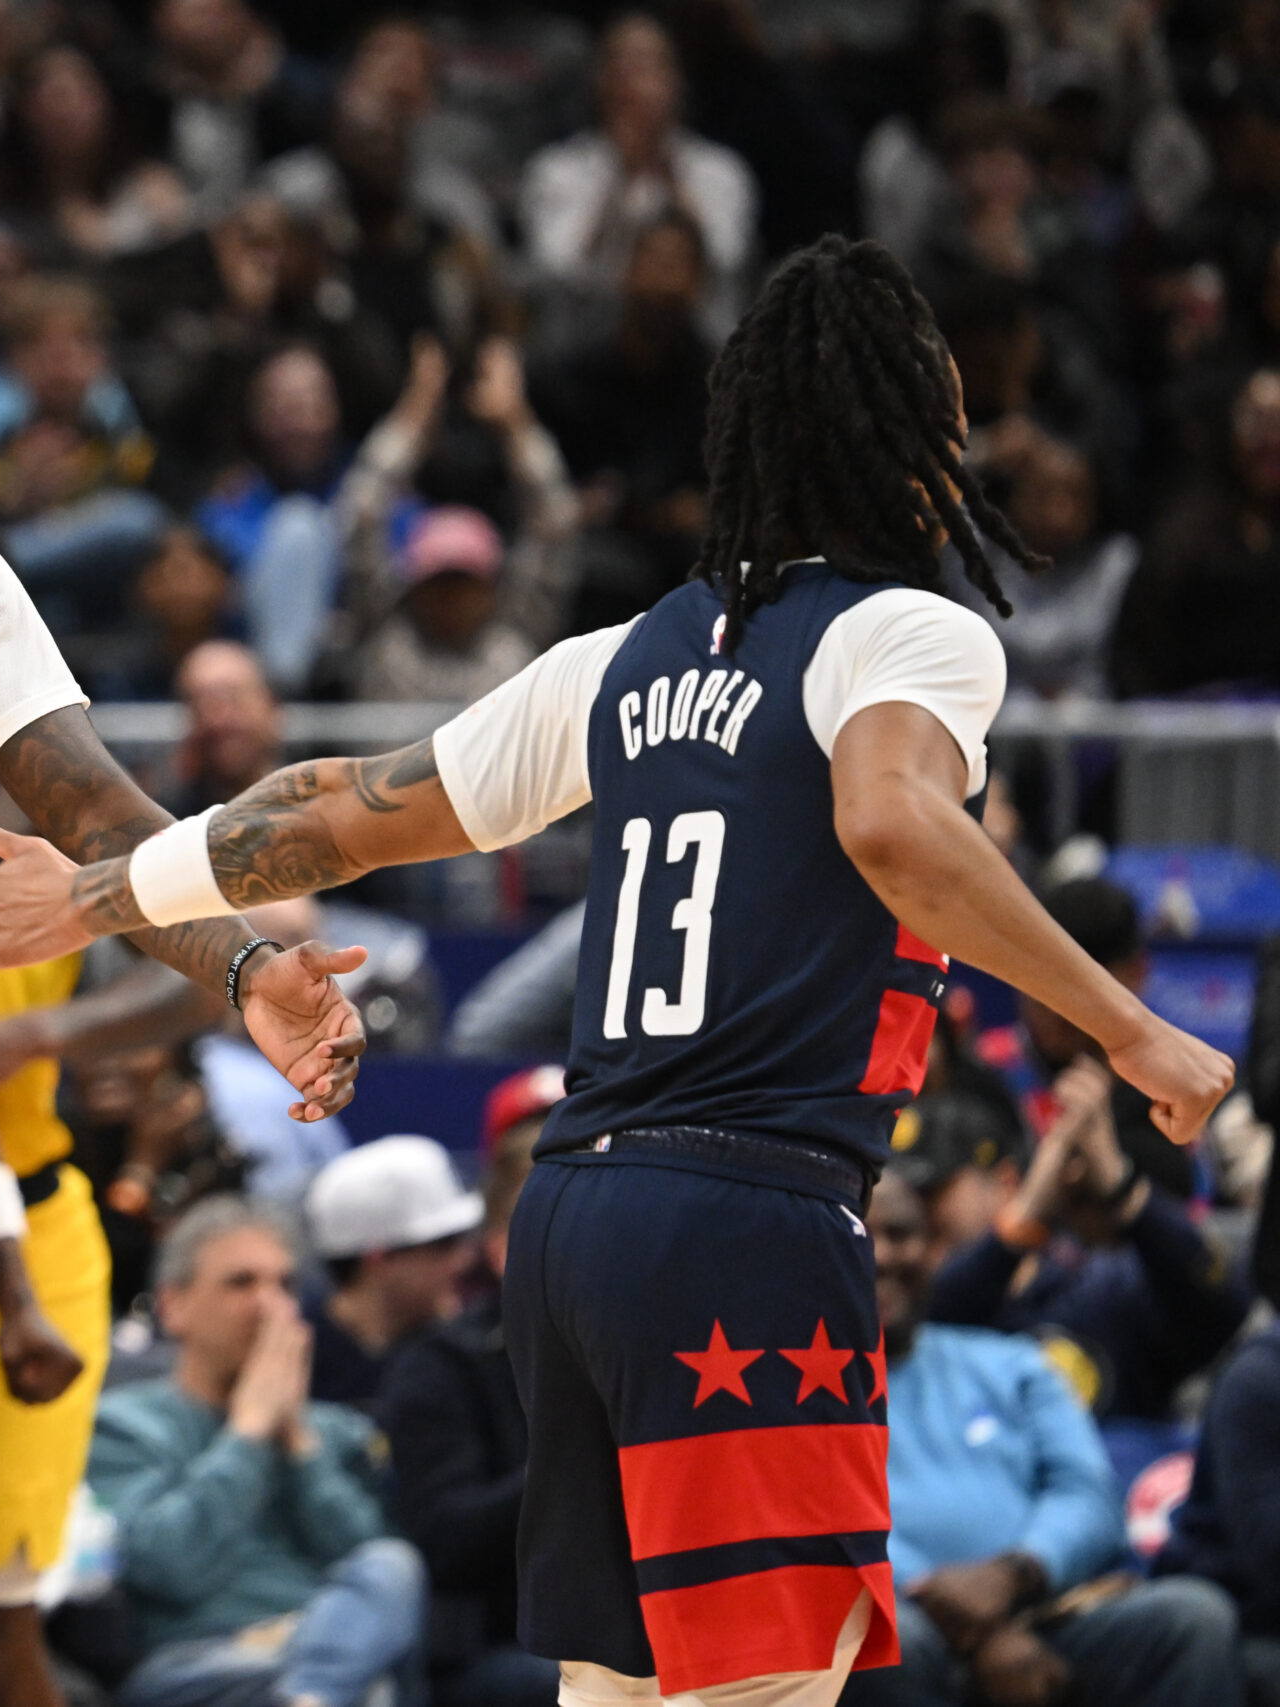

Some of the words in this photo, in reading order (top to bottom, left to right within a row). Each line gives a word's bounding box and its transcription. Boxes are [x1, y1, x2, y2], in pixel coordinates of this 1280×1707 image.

[619, 668, 763, 761] COOPER
[603, 810, 726, 1040] 13
[227, 972, 236, 987] OF
[231, 949, 248, 972] PART
